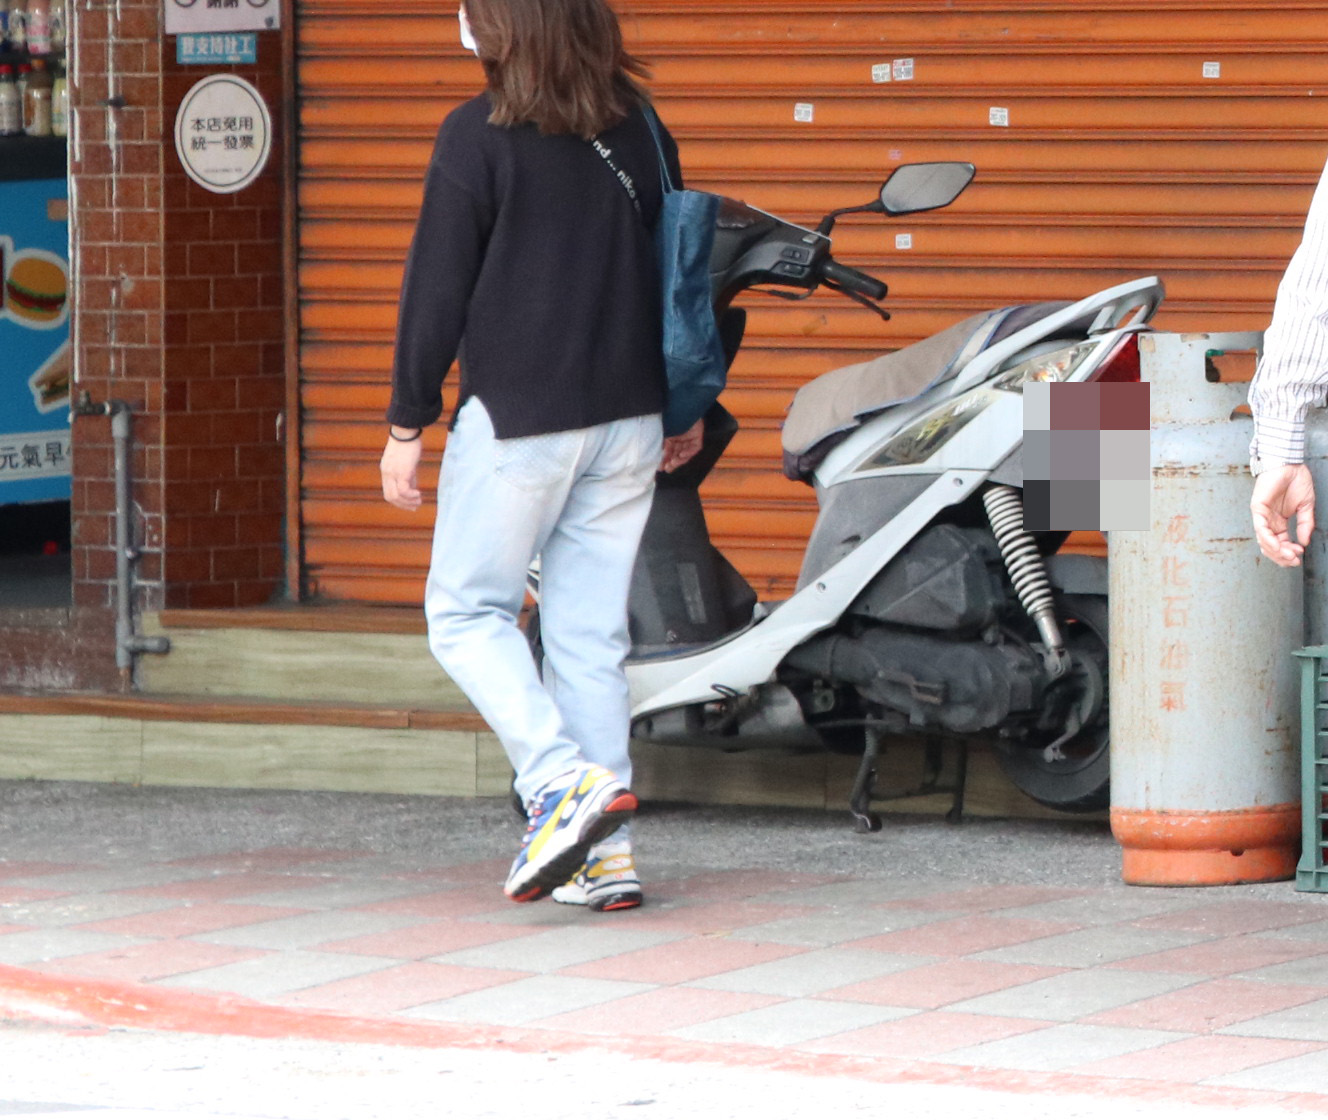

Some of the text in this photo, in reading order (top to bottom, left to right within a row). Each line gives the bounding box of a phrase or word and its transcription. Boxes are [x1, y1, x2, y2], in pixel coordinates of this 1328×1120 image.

[191, 117, 253, 132] 本店免用
[191, 136, 255, 151] 統一發票
[0, 442, 71, 469] 元氣早
[1159, 514, 1190, 713] 液化石油氣
